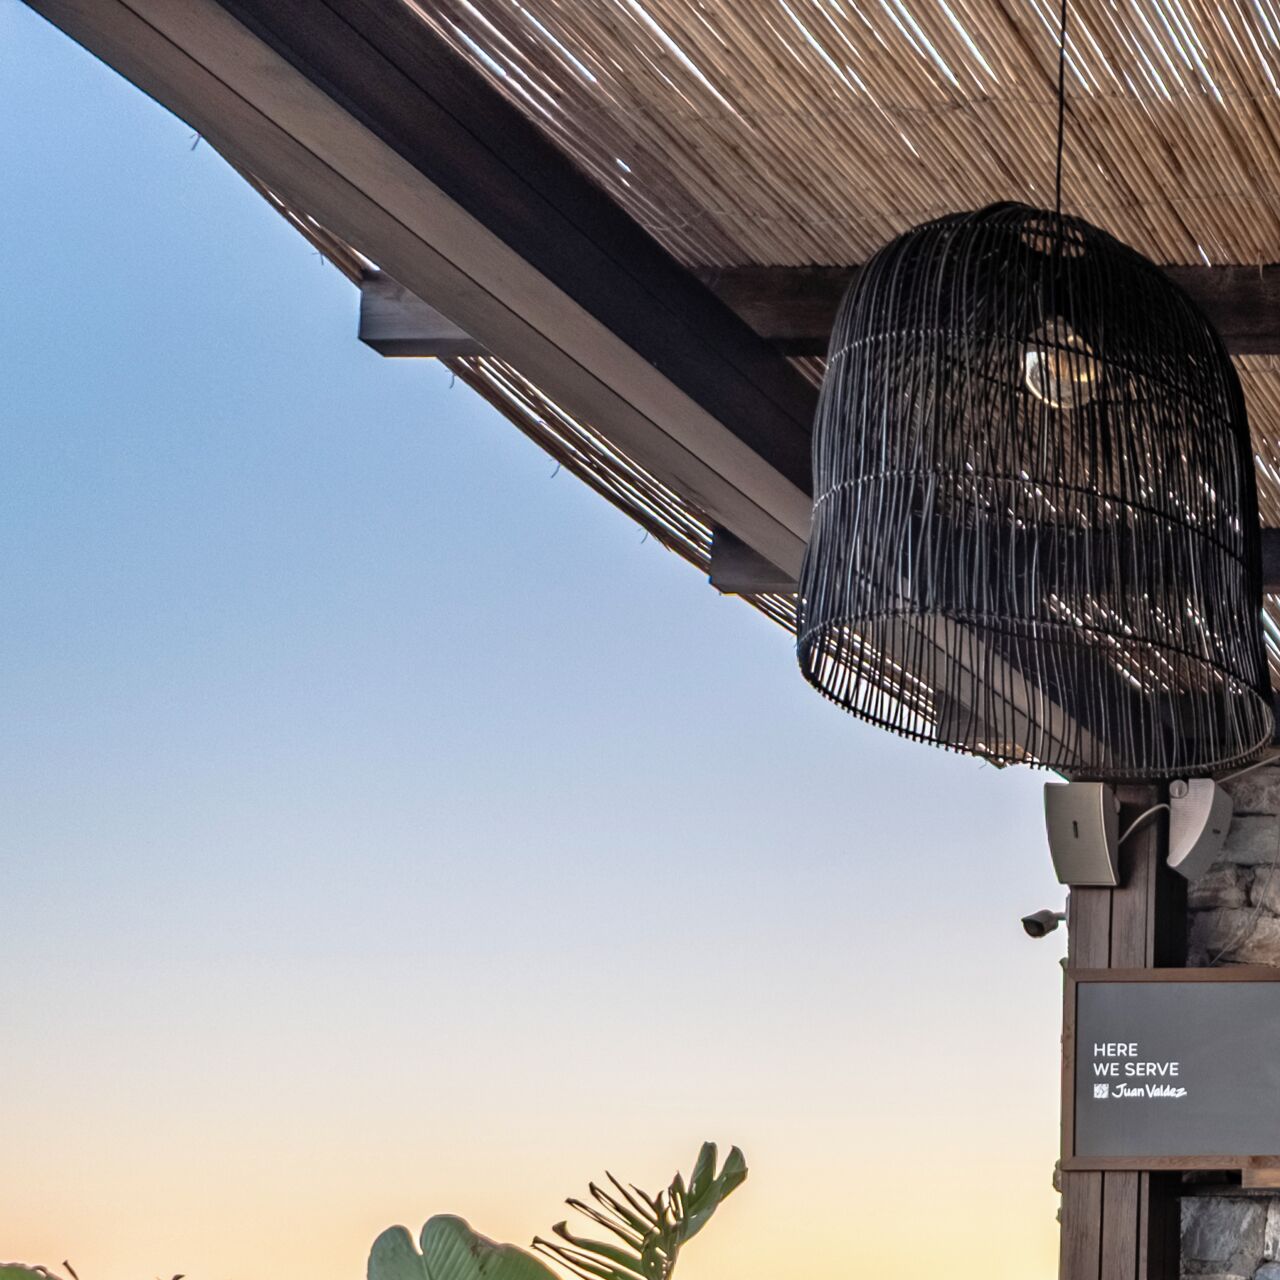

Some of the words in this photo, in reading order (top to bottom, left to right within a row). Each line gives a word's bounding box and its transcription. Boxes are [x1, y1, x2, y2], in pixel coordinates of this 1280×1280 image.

[1093, 1042, 1138, 1057] HERE
[1093, 1062, 1120, 1077] WE
[1124, 1062, 1179, 1077] SERVE
[1111, 1082, 1145, 1099] Juan
[1145, 1083, 1188, 1099] Valdez
